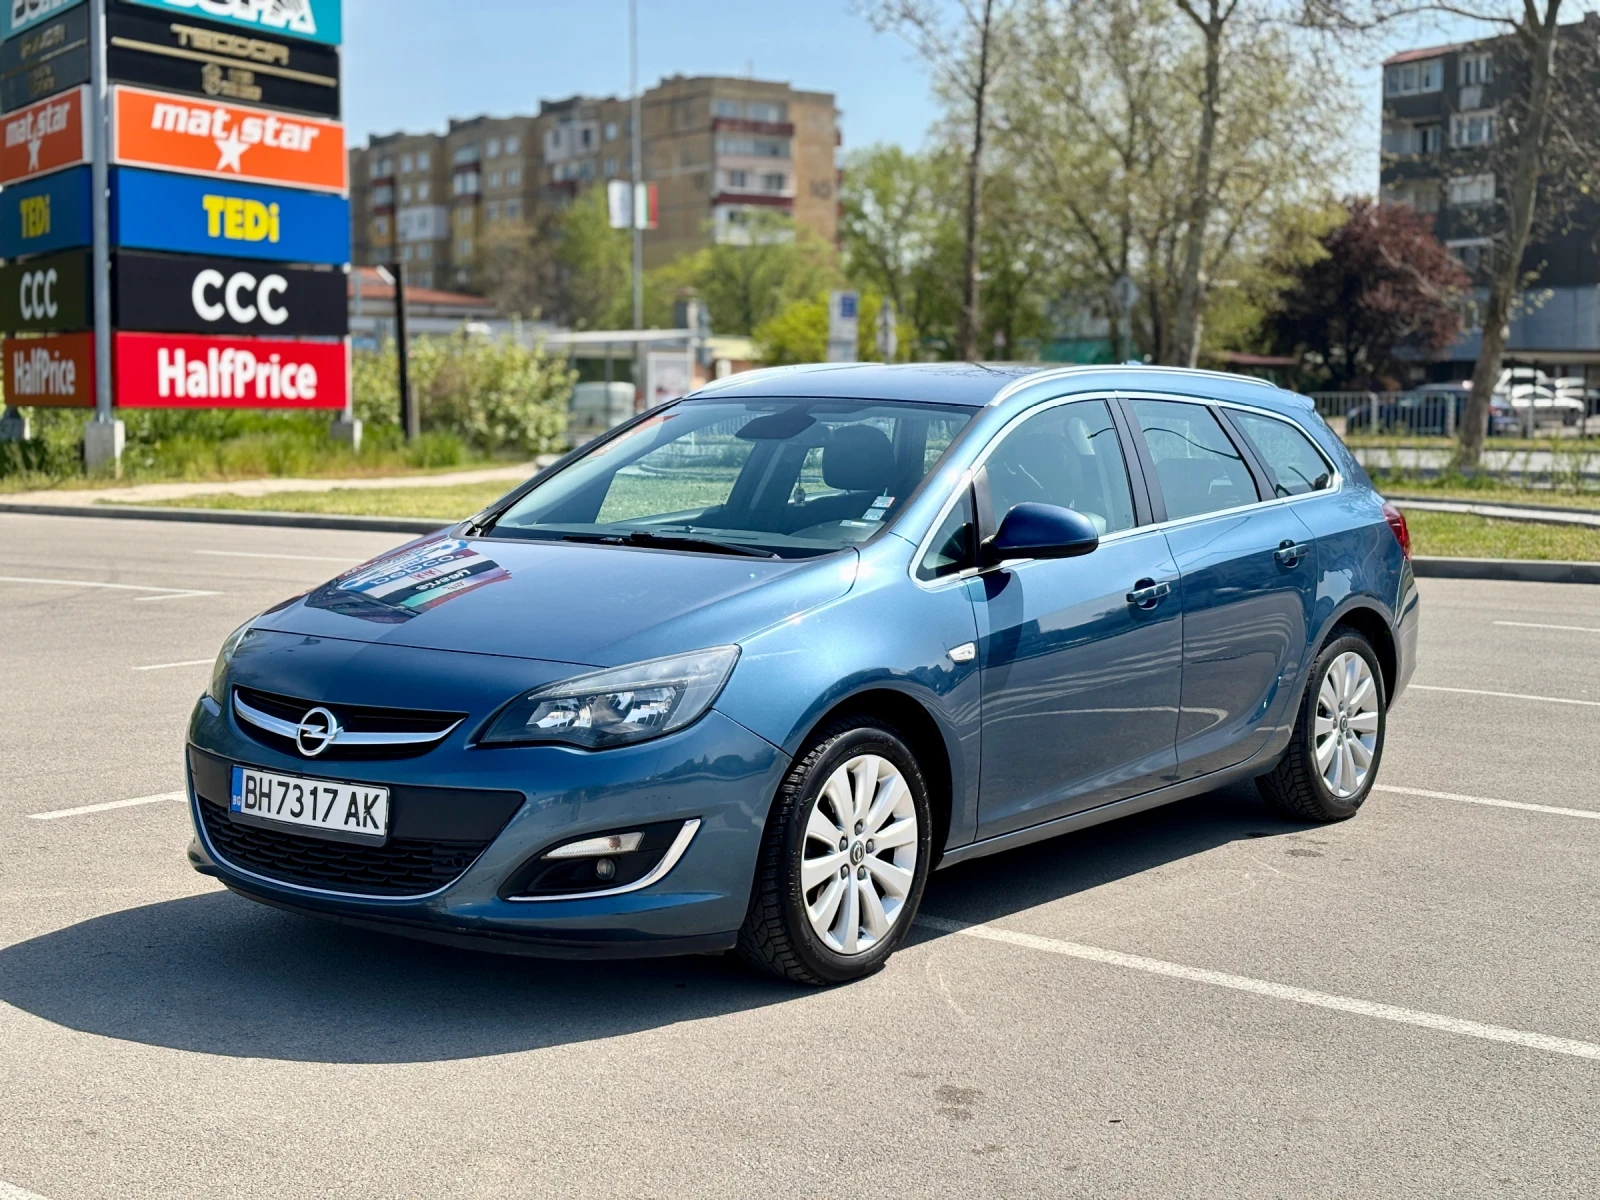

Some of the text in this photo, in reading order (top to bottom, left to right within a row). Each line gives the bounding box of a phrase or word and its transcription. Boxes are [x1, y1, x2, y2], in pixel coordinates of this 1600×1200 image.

[151, 102, 320, 152] mat star
[20, 194, 50, 239] TEDi
[203, 194, 280, 243] TEDi
[20, 268, 58, 320] CCC
[192, 269, 289, 325] CCC
[14, 346, 76, 395] HalfPrice
[157, 347, 318, 398] HalfPrice
[232, 795, 242, 806] BG
